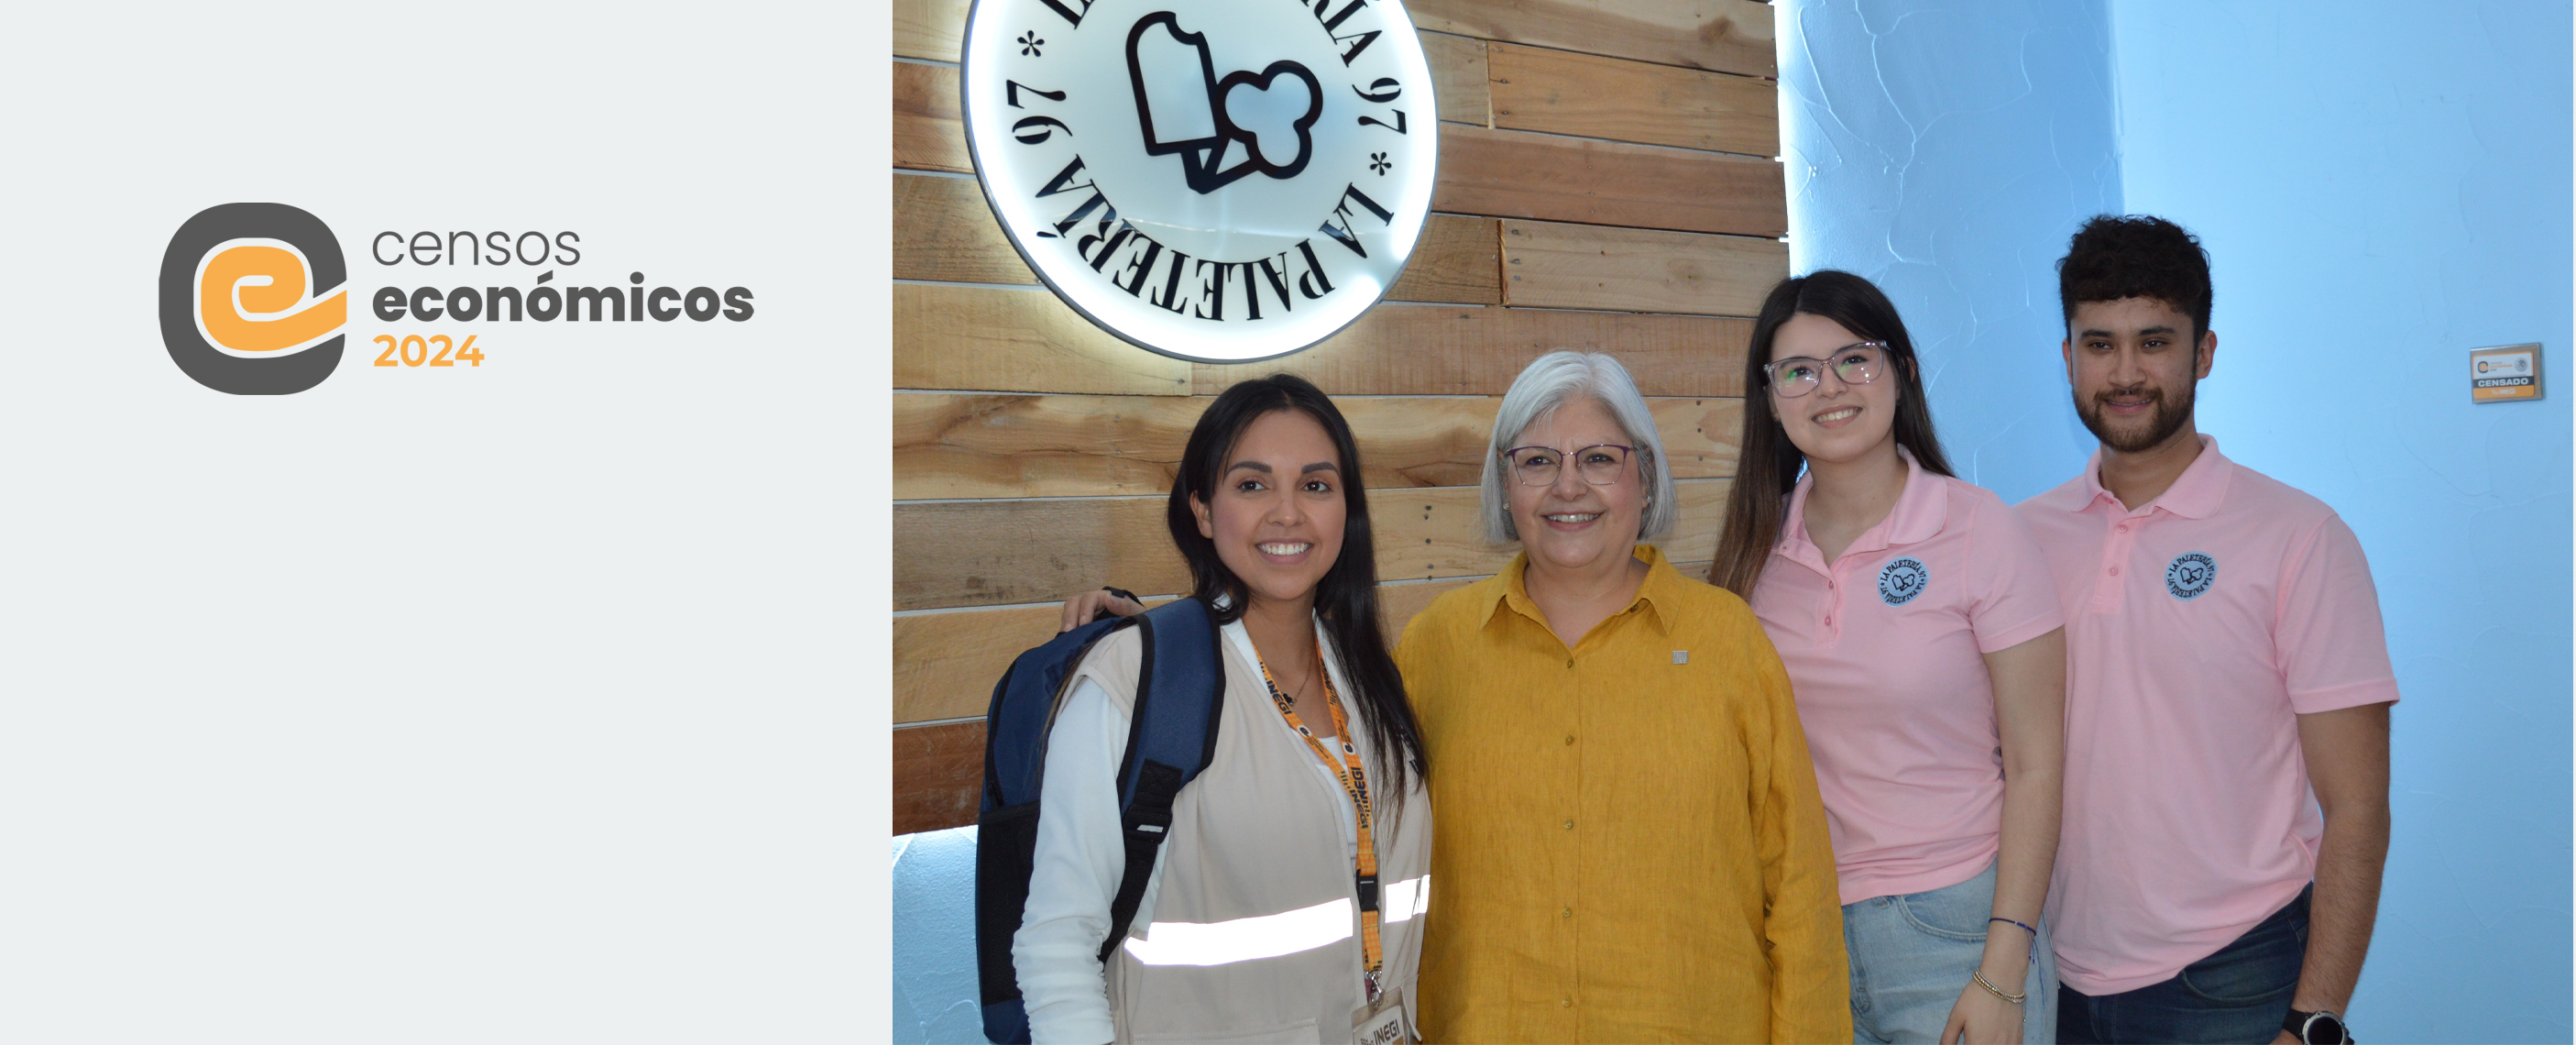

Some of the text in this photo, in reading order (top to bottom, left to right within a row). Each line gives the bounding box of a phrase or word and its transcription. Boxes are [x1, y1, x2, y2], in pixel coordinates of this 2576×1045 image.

[1352, 77, 1408, 136] 97
[1005, 79, 1395, 322] LA PALETERÍA 97
[2478, 378, 2528, 387] CENSADO
[1880, 572, 1891, 581] LA
[1886, 559, 1922, 575] PALETERÍA
[2168, 563, 2180, 573] LA
[2176, 554, 2212, 567] PALETERÍA
[1266, 679, 1293, 715] INEGI
[1350, 766, 1369, 804] INEGI
[1349, 789, 1369, 829] INEGI
[1373, 1018, 1400, 1045] INEGI
